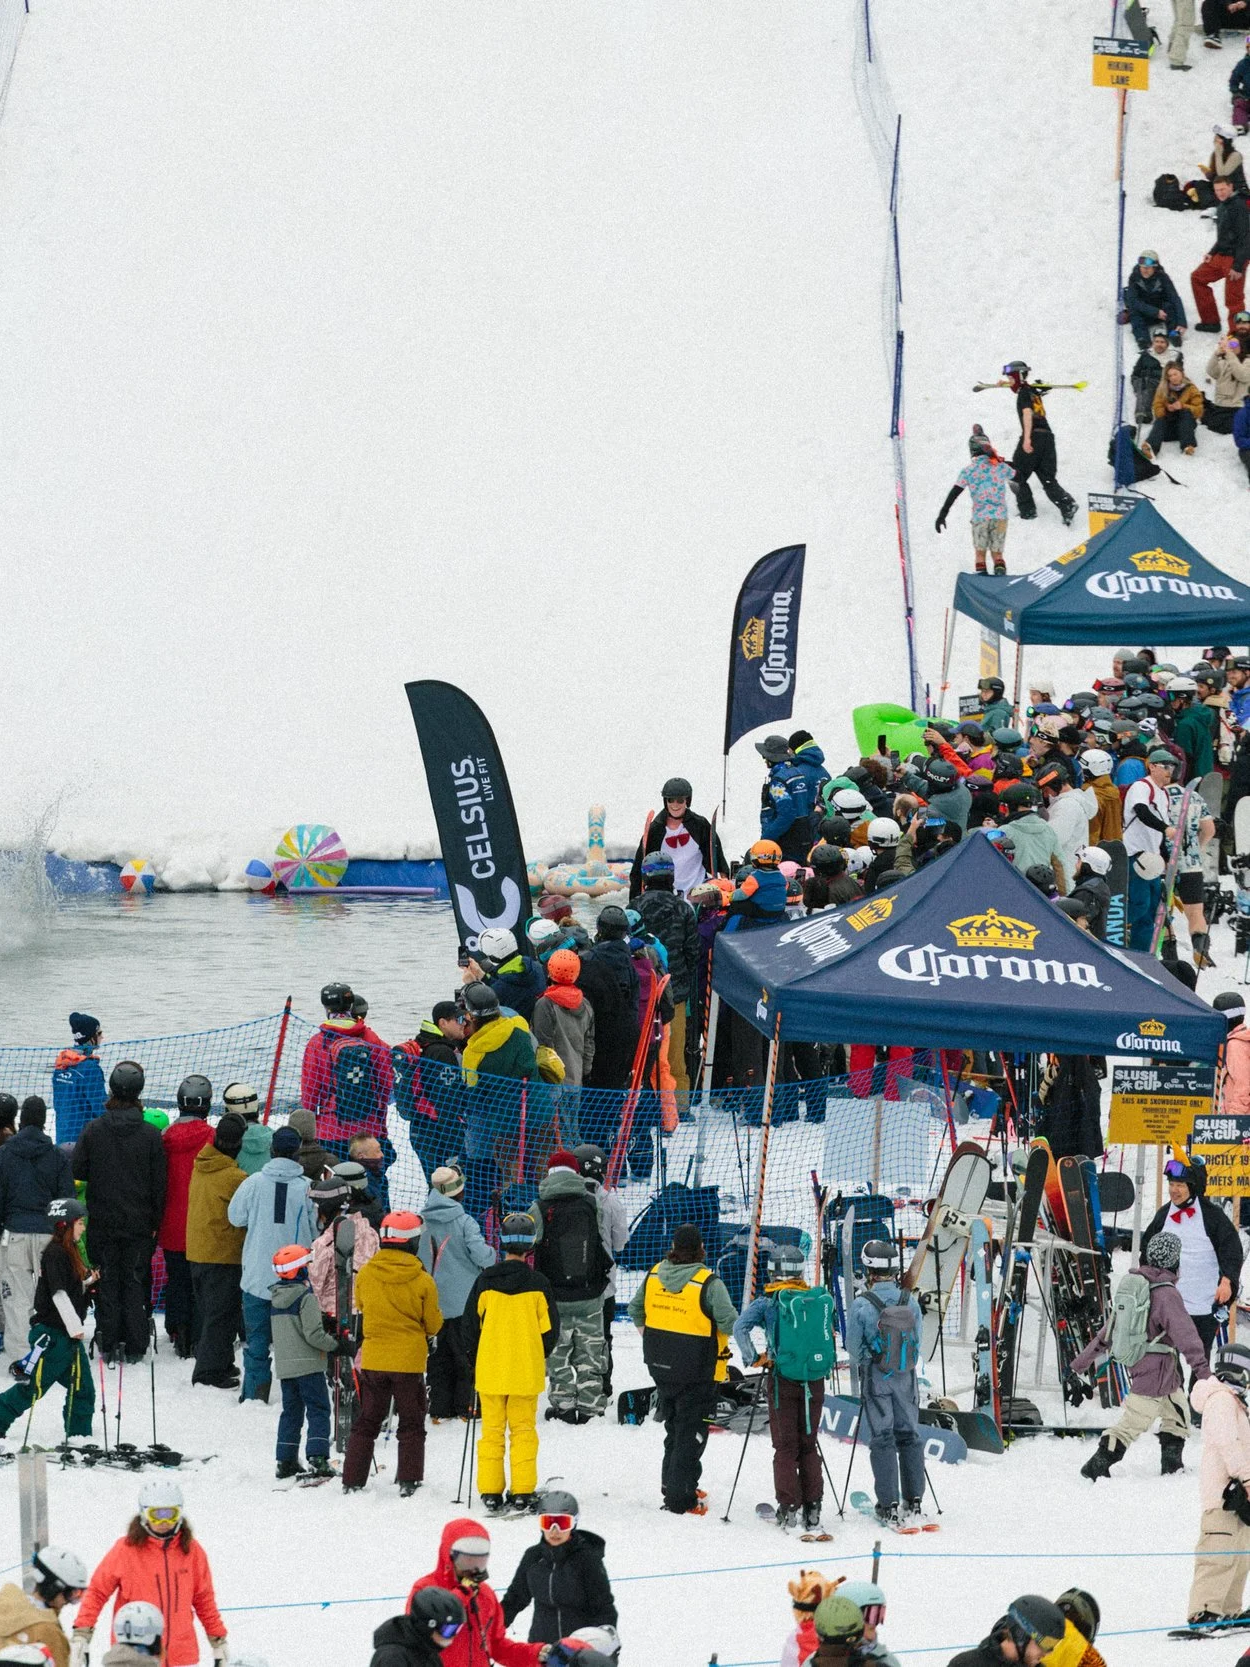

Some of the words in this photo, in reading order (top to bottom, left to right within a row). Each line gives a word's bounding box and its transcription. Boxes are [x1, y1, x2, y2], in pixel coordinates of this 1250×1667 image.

[1085, 570, 1239, 601] Corona
[758, 588, 795, 697] Corona
[476, 757, 488, 774] FIT
[480, 776, 494, 802] LIVE
[450, 757, 496, 880] CELSIUS
[877, 943, 1106, 989] Corona
[1116, 1032, 1183, 1053] Corona
[1114, 1069, 1158, 1081] SLUSH
[1134, 1080, 1162, 1091] CUP
[1194, 1119, 1237, 1130] SLUSH
[1213, 1129, 1241, 1140] CUP
